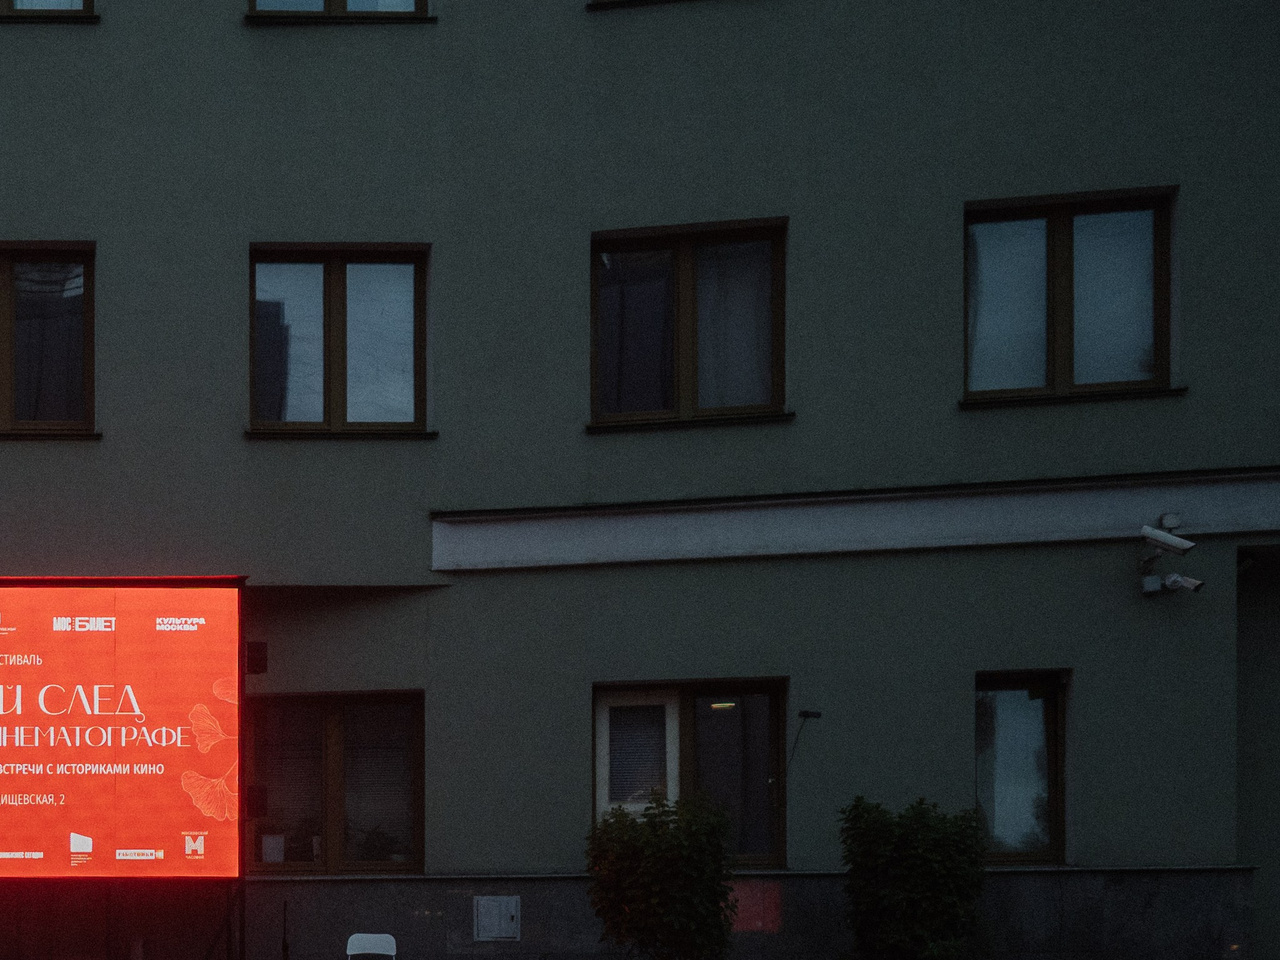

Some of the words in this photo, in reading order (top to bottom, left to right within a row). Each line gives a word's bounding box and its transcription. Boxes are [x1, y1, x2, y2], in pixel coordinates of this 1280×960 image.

[38, 684, 146, 723] СЛЕД
[46, 763, 54, 774] С
[56, 763, 131, 774] ИСТОРИКАМИ
[133, 763, 165, 774] КИНО
[59, 794, 65, 805] 2
